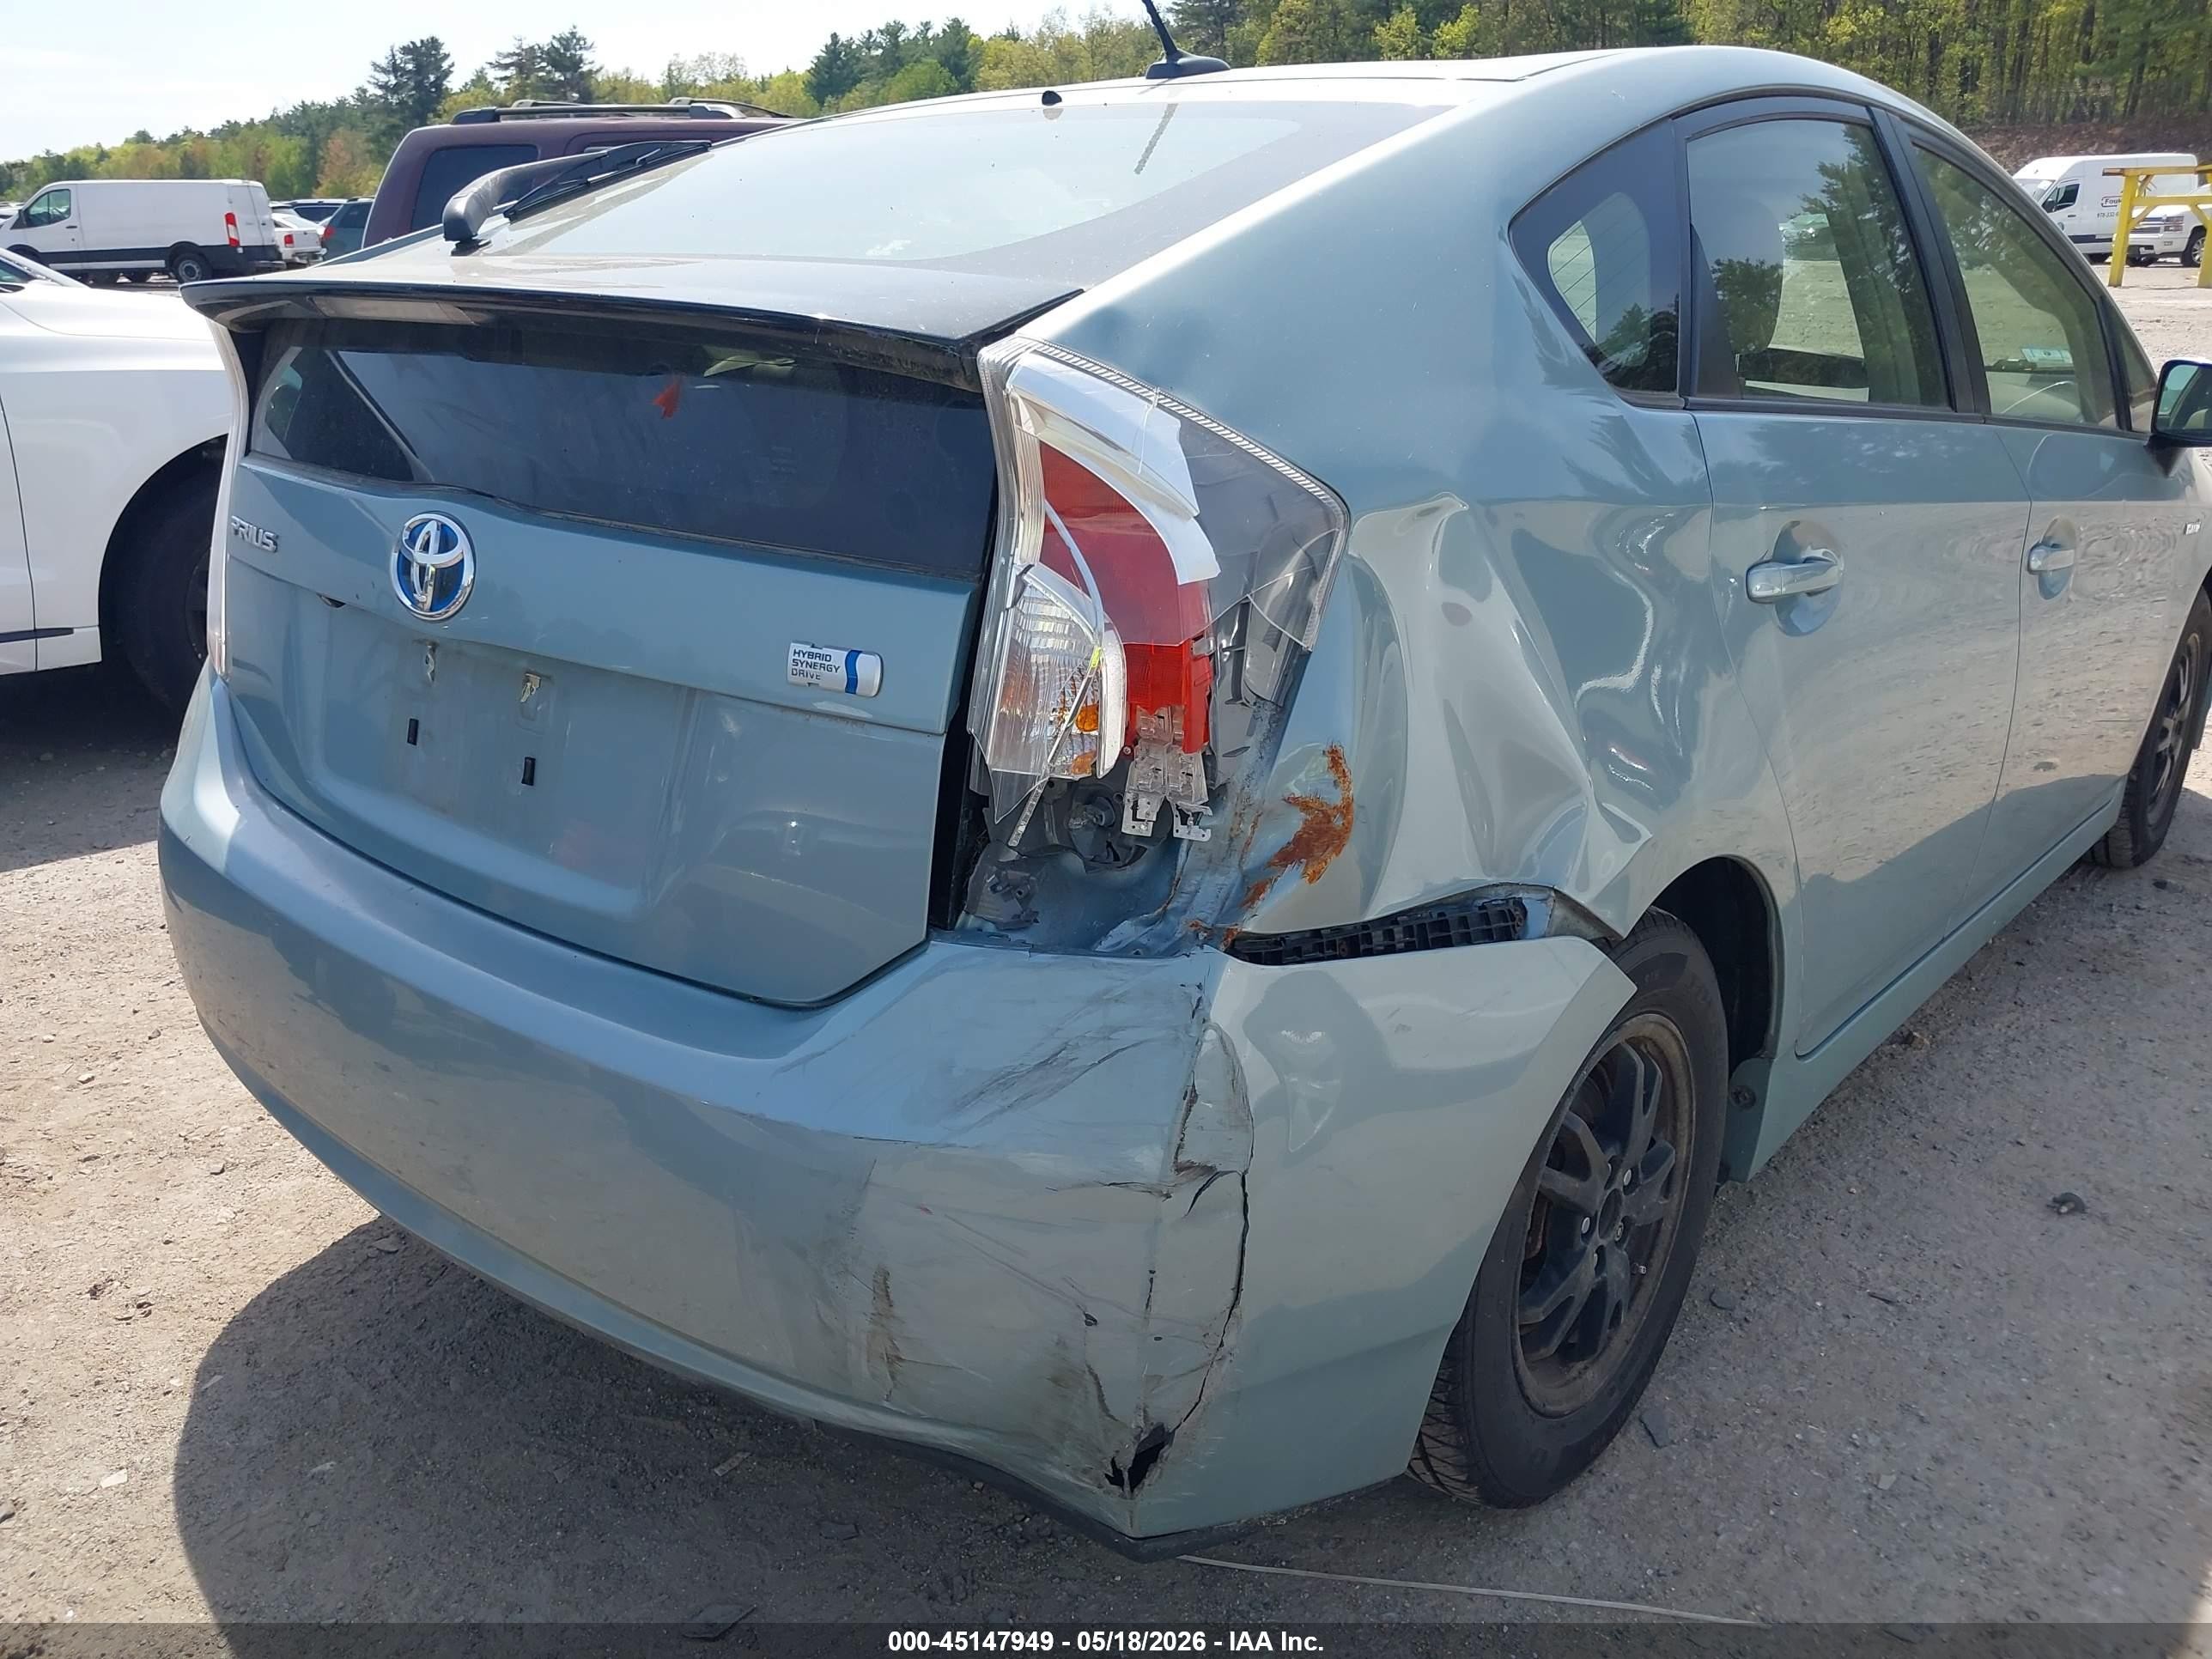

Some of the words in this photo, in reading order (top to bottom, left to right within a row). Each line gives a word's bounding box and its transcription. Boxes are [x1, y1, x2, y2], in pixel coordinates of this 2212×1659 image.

[231, 515, 278, 553] PRIUS
[793, 648, 832, 663] HYBRID
[792, 658, 841, 673] SYNERGY
[791, 668, 821, 680] DRIVE
